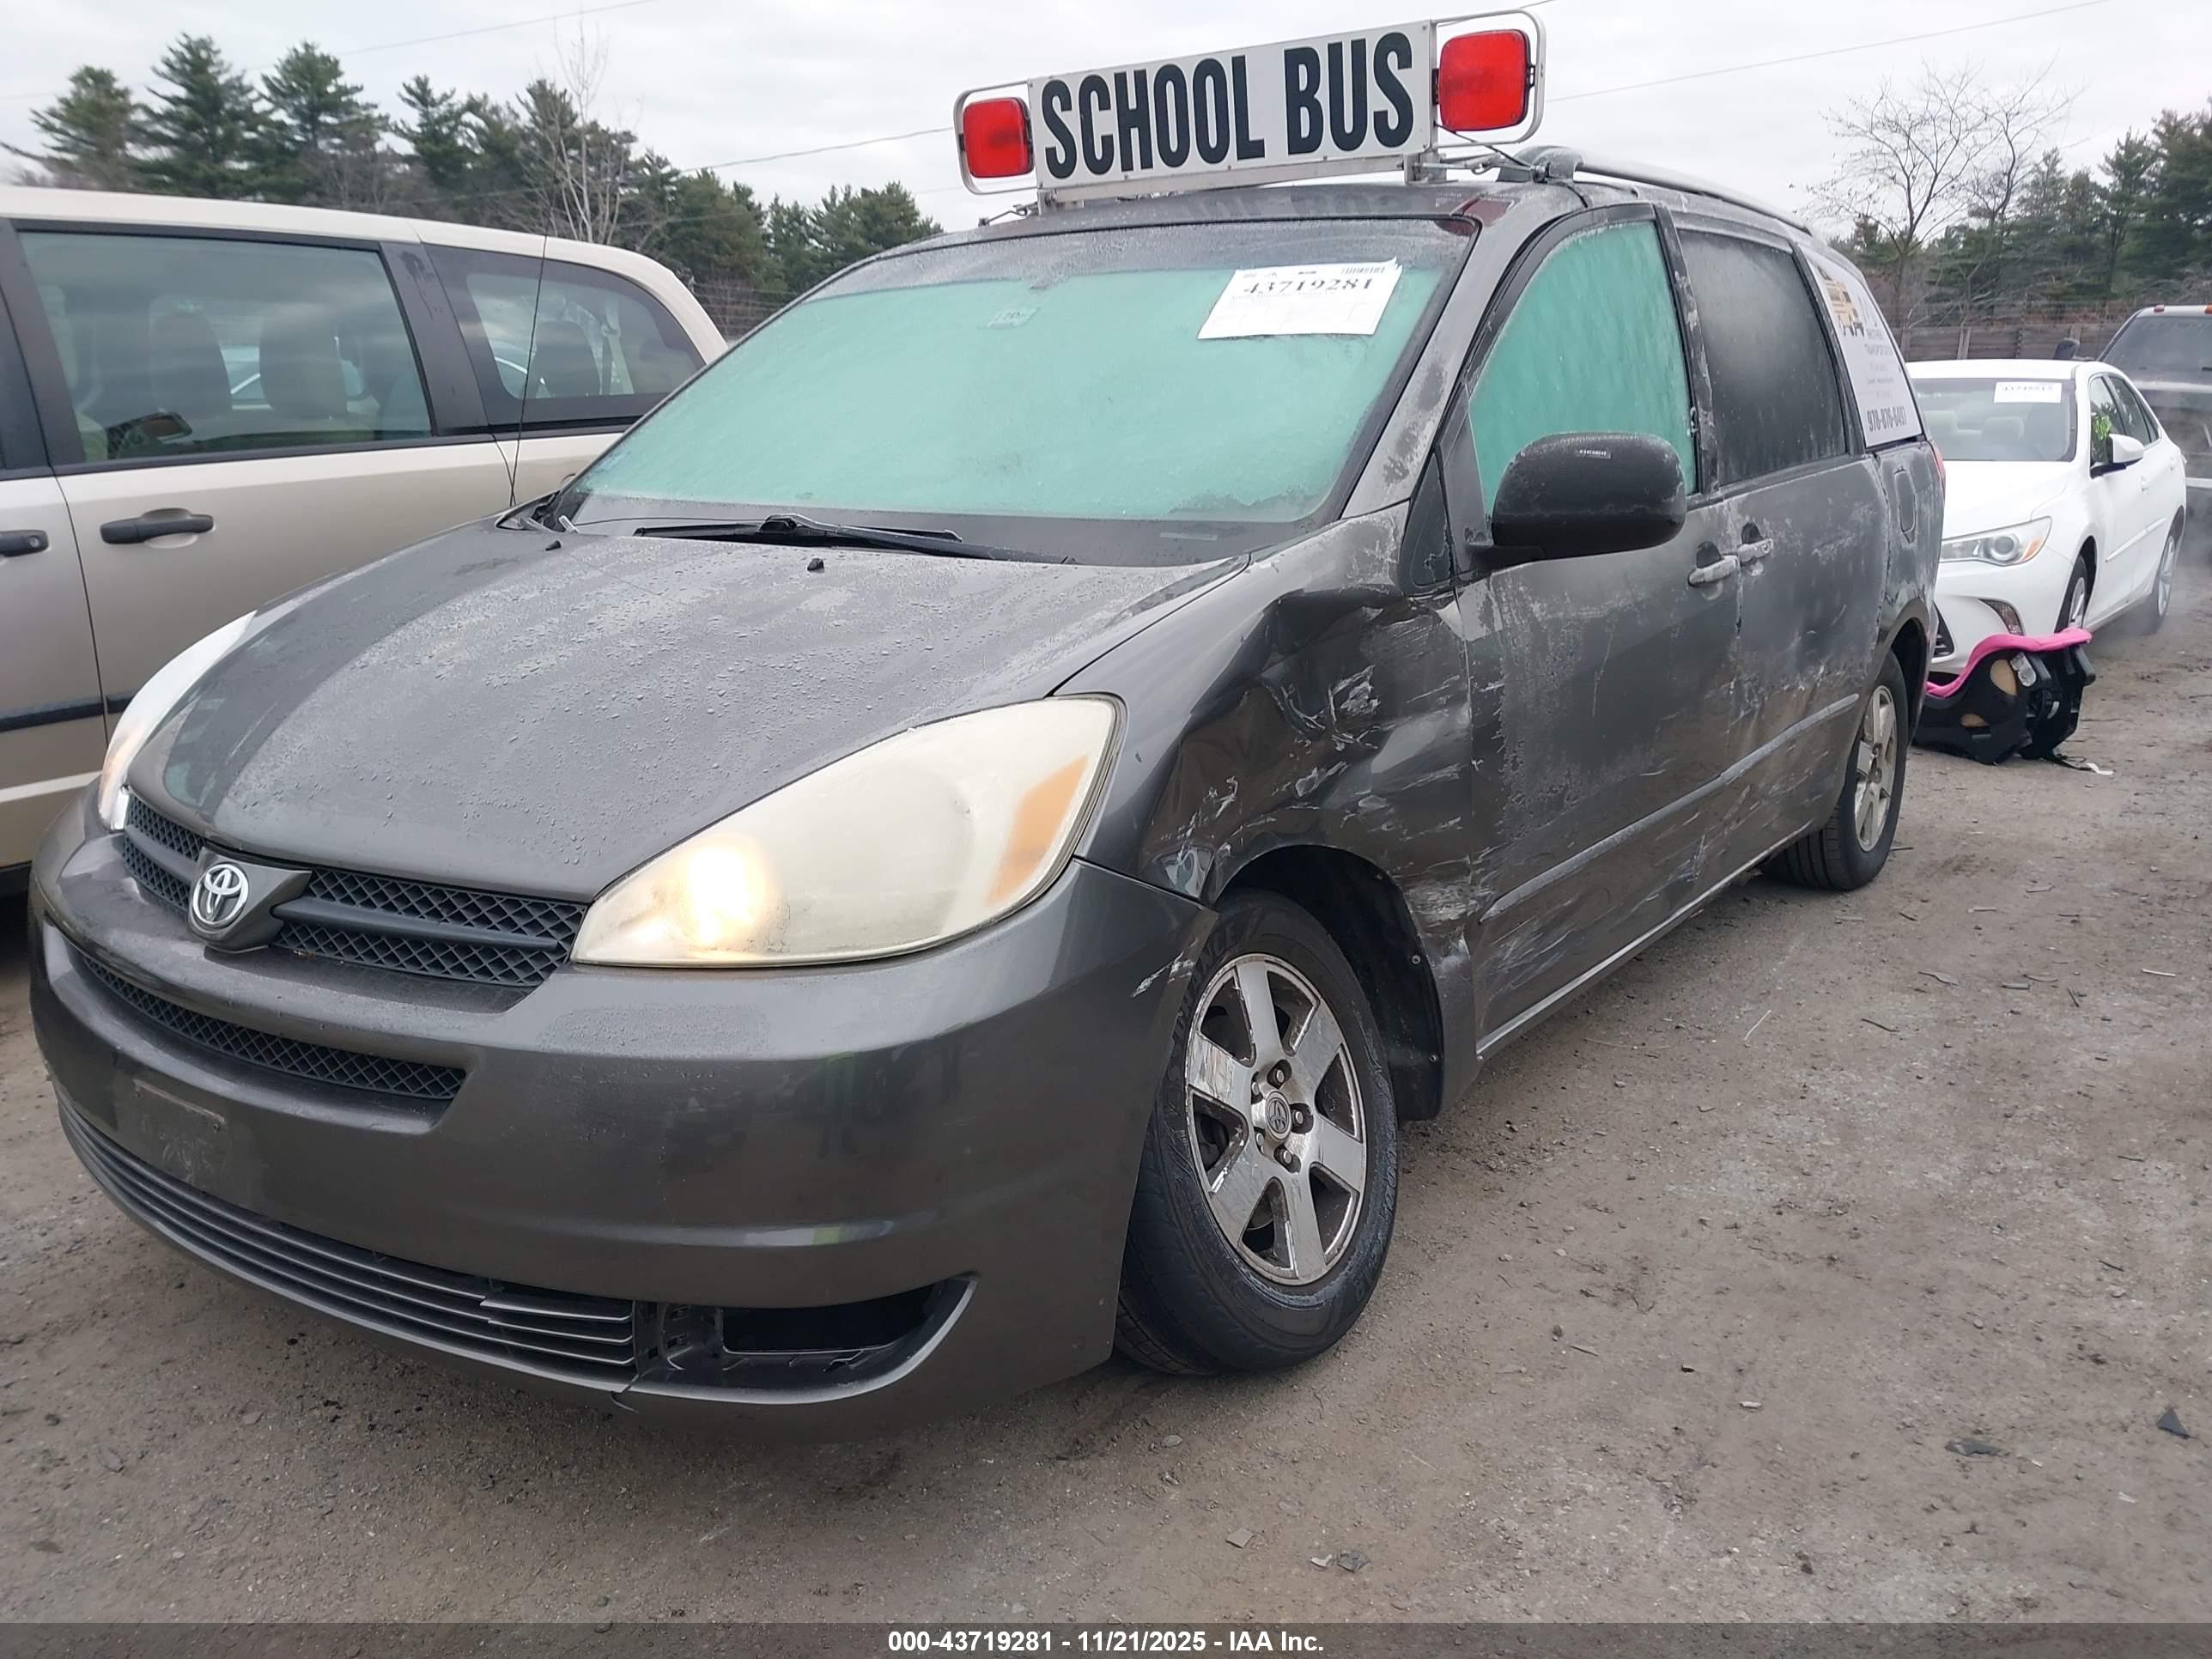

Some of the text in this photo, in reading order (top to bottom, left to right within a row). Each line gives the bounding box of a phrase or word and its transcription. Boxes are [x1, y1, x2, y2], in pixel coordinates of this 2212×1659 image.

[1042, 33, 1413, 179] SCHOOL BUS
[1244, 278, 1373, 294] 43719281
